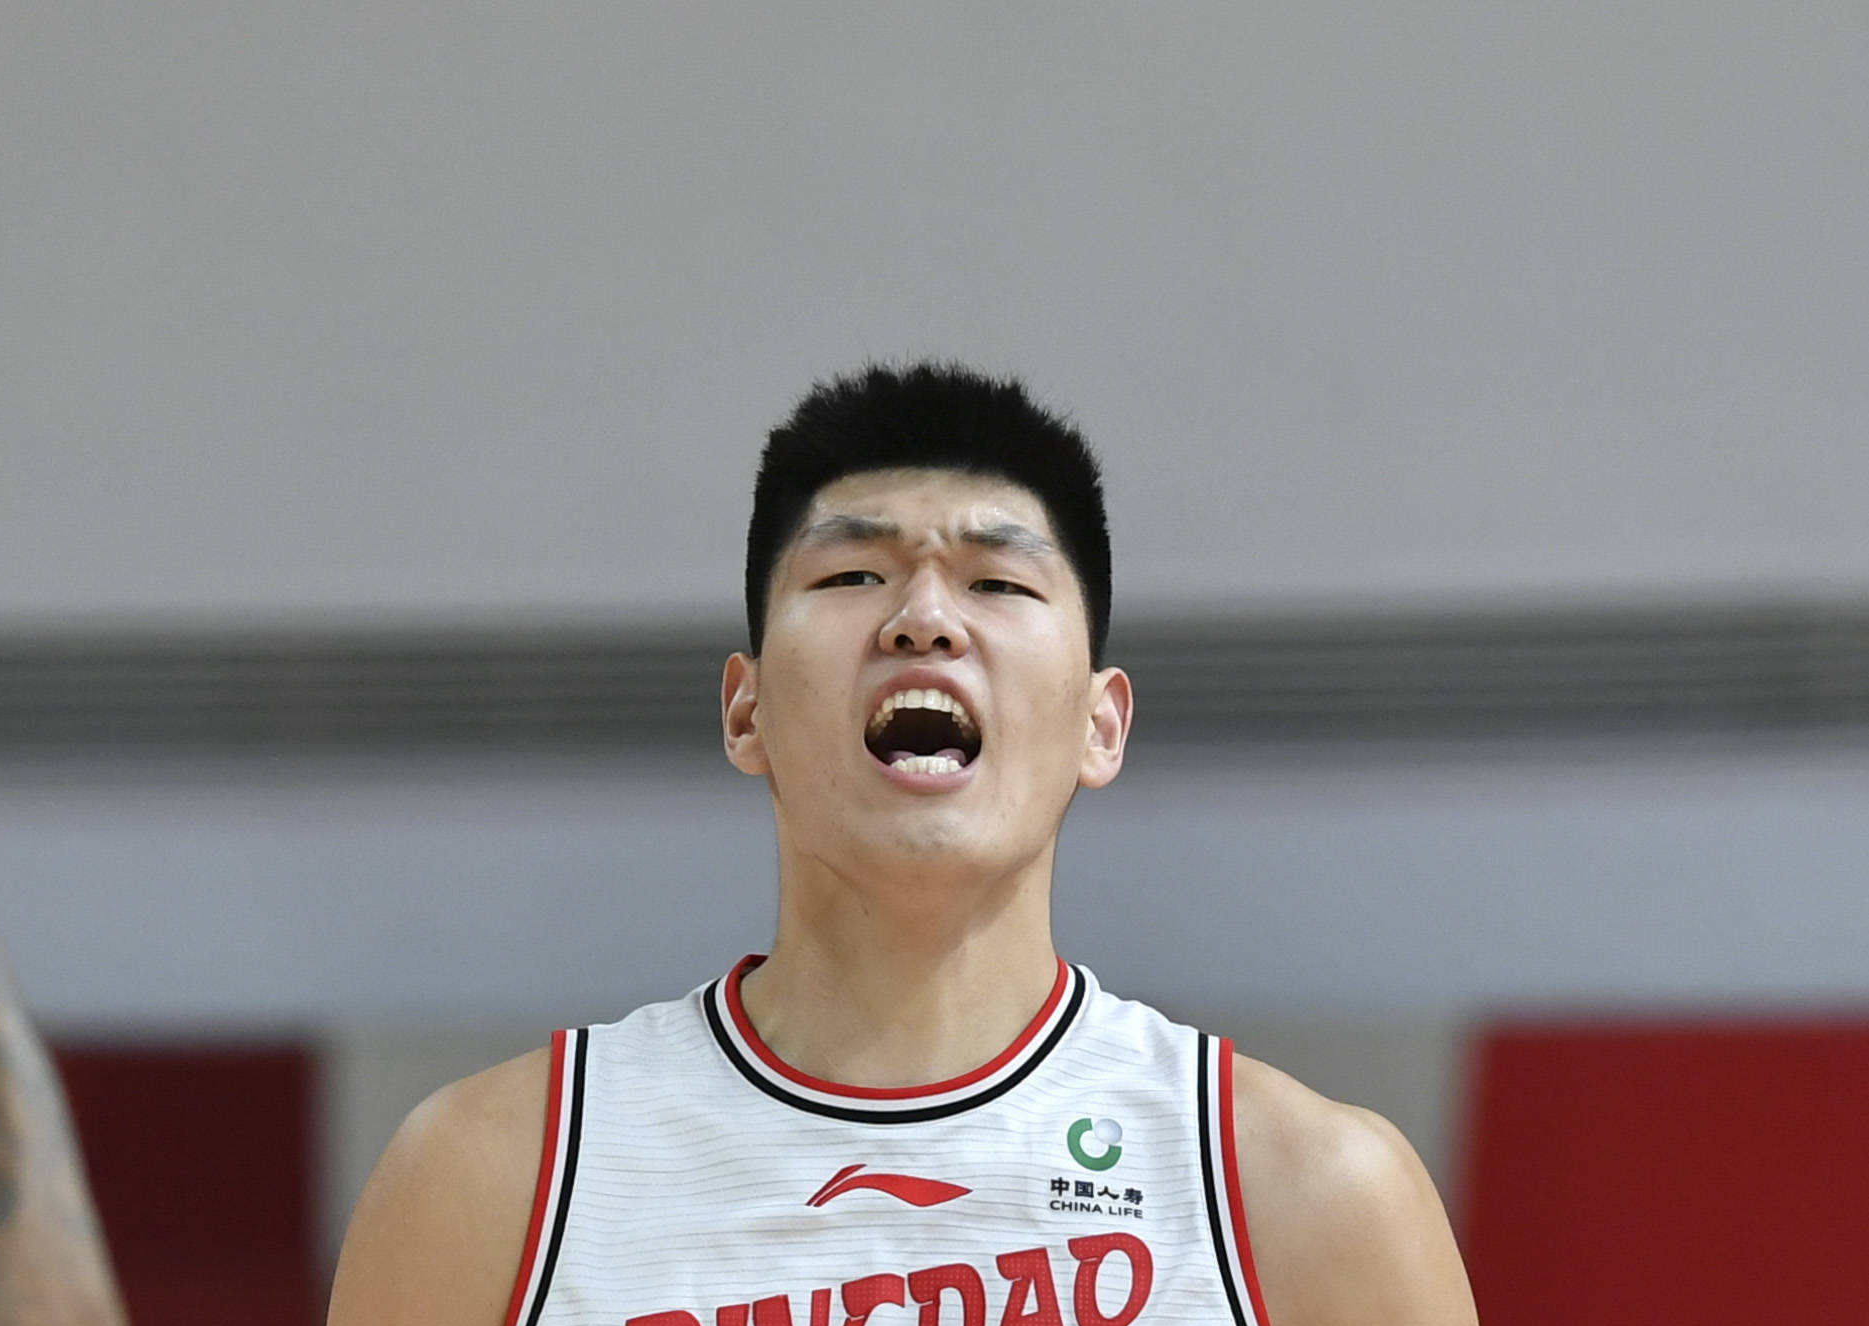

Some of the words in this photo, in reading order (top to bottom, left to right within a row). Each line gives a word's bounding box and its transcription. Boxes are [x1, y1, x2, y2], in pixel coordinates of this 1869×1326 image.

[1049, 1176, 1144, 1206] 中国人寿
[1049, 1199, 1104, 1214] CHINA
[1108, 1205, 1144, 1219] LIFE
